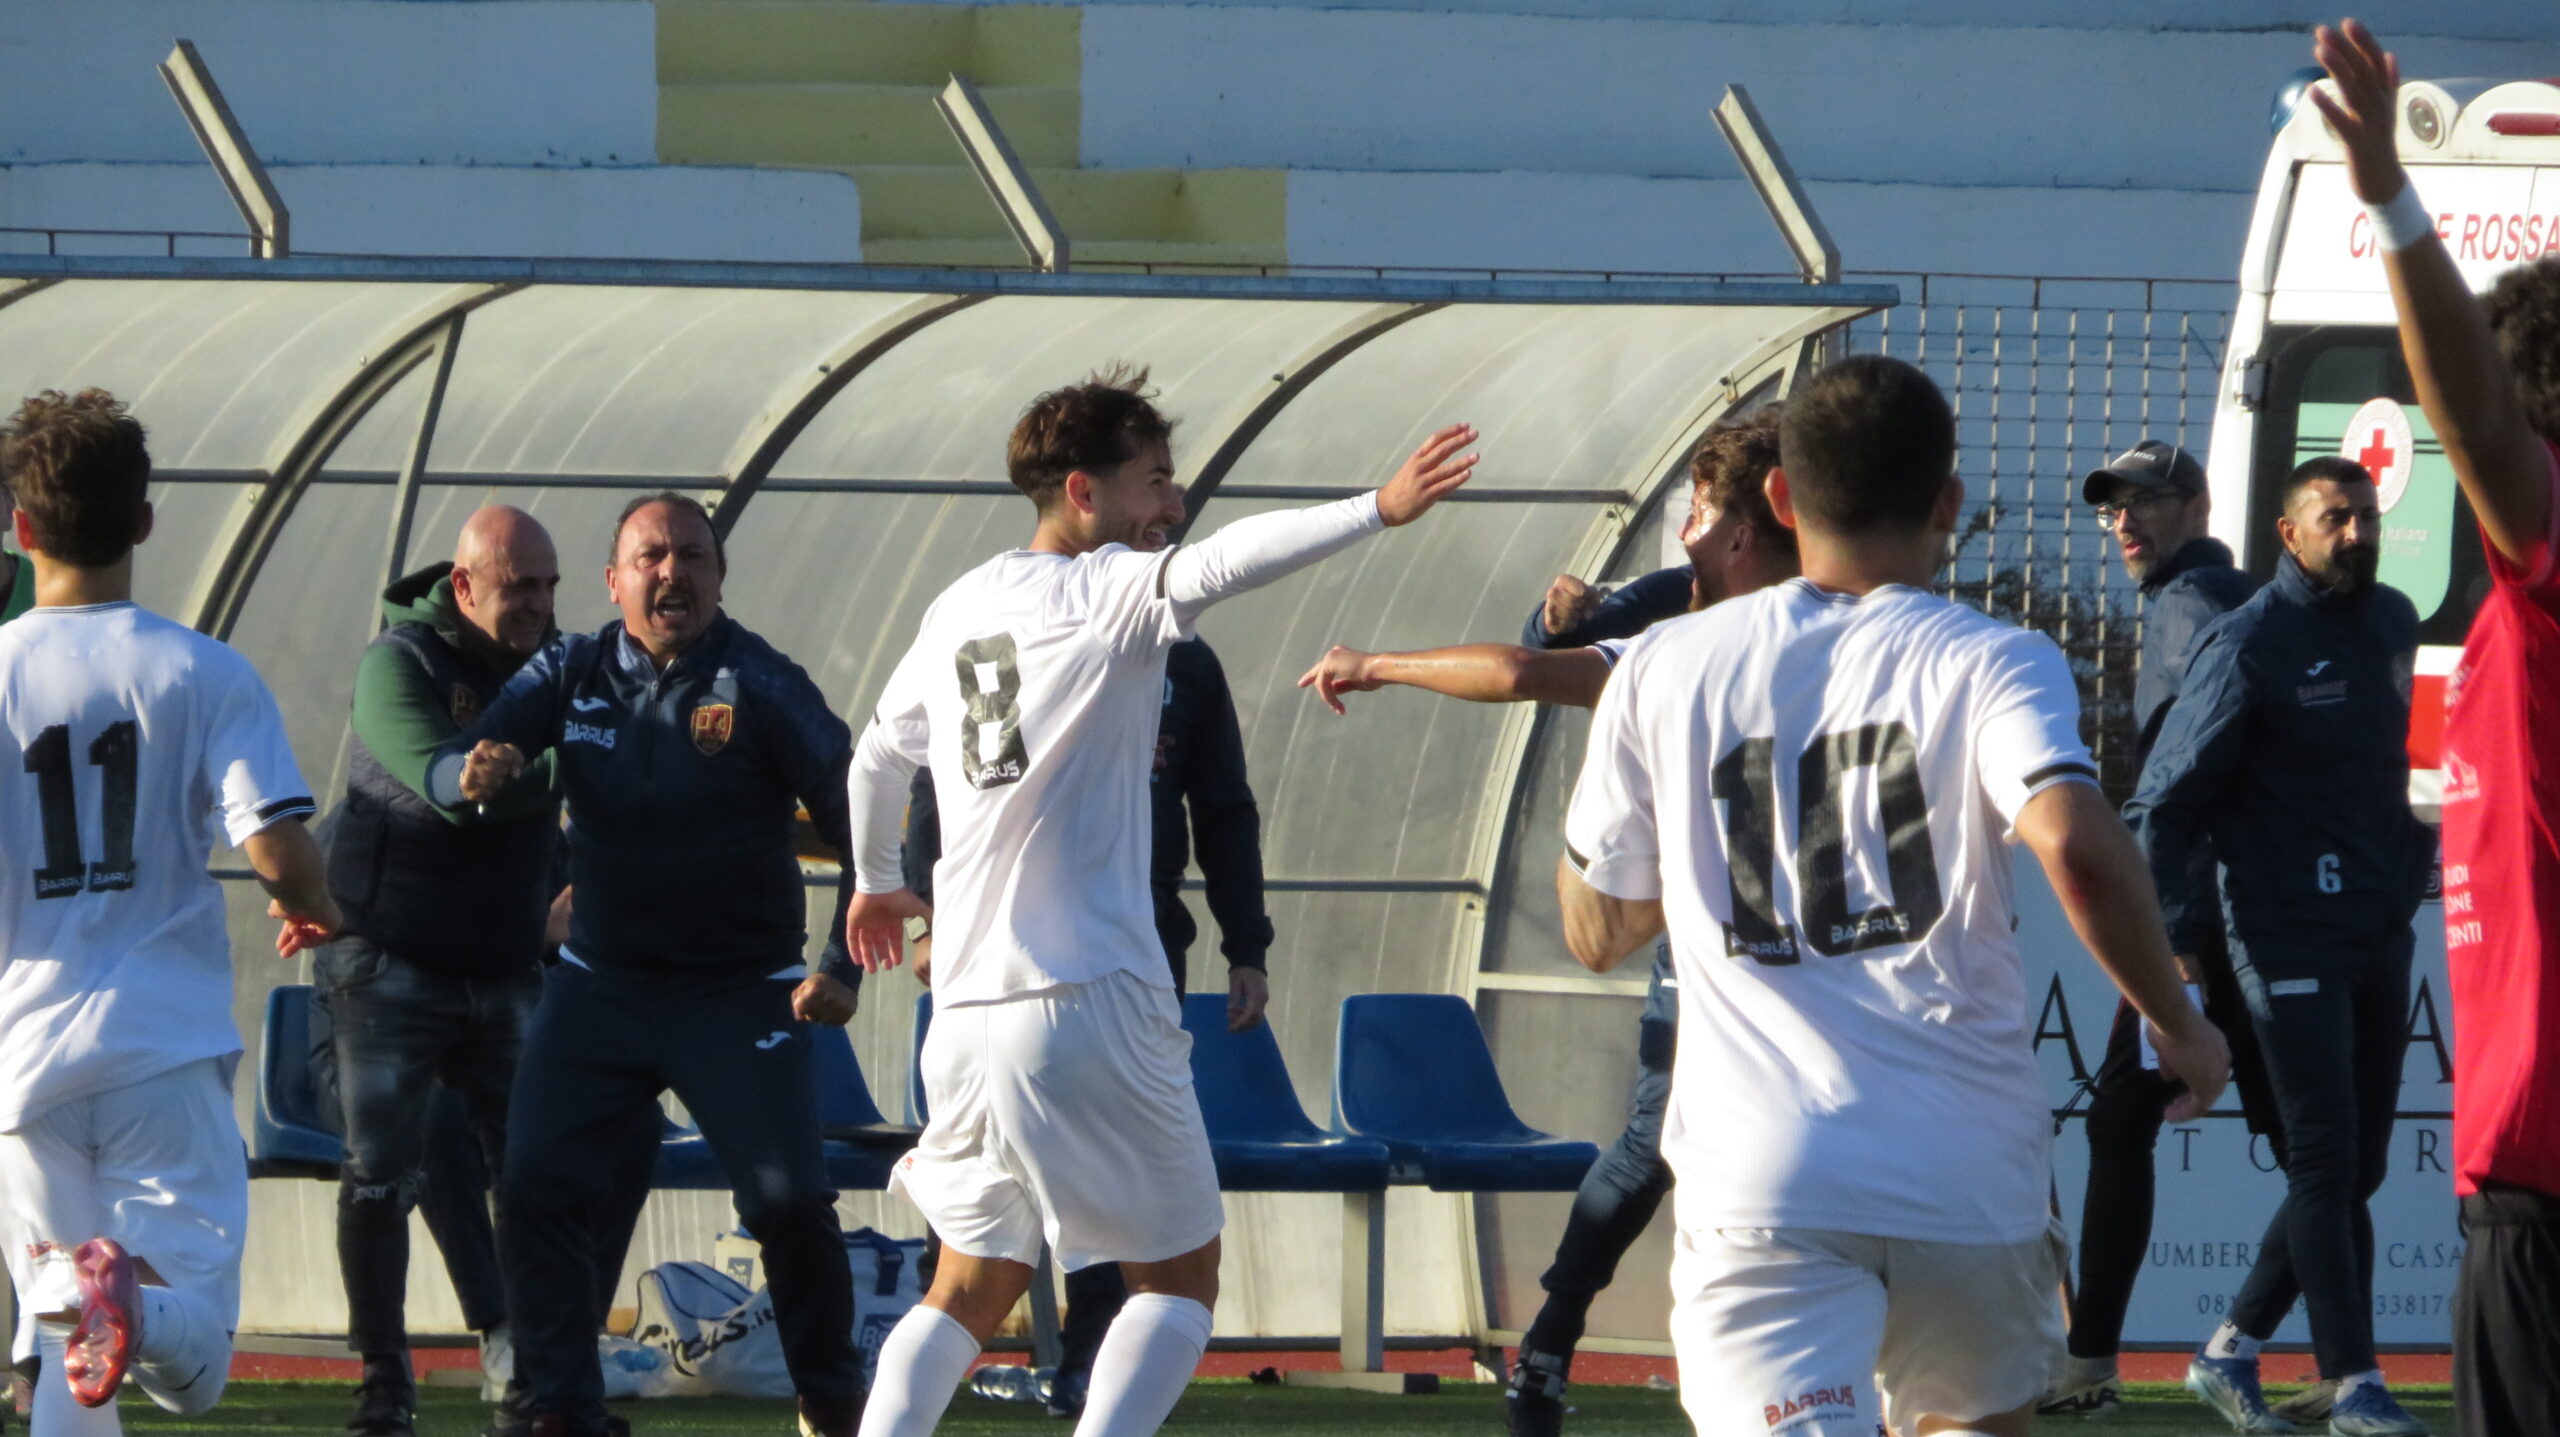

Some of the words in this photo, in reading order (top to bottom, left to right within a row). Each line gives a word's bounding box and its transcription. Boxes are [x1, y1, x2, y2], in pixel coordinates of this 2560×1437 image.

[954, 630, 1030, 791] 8
[564, 719, 616, 750] BARRUS
[23, 719, 138, 900] 11
[1711, 721, 1943, 966] 10
[1831, 912, 1910, 945] BARRUS
[2151, 1242, 2263, 1268] UMBER
[1764, 1384, 1856, 1428] BARRUS
